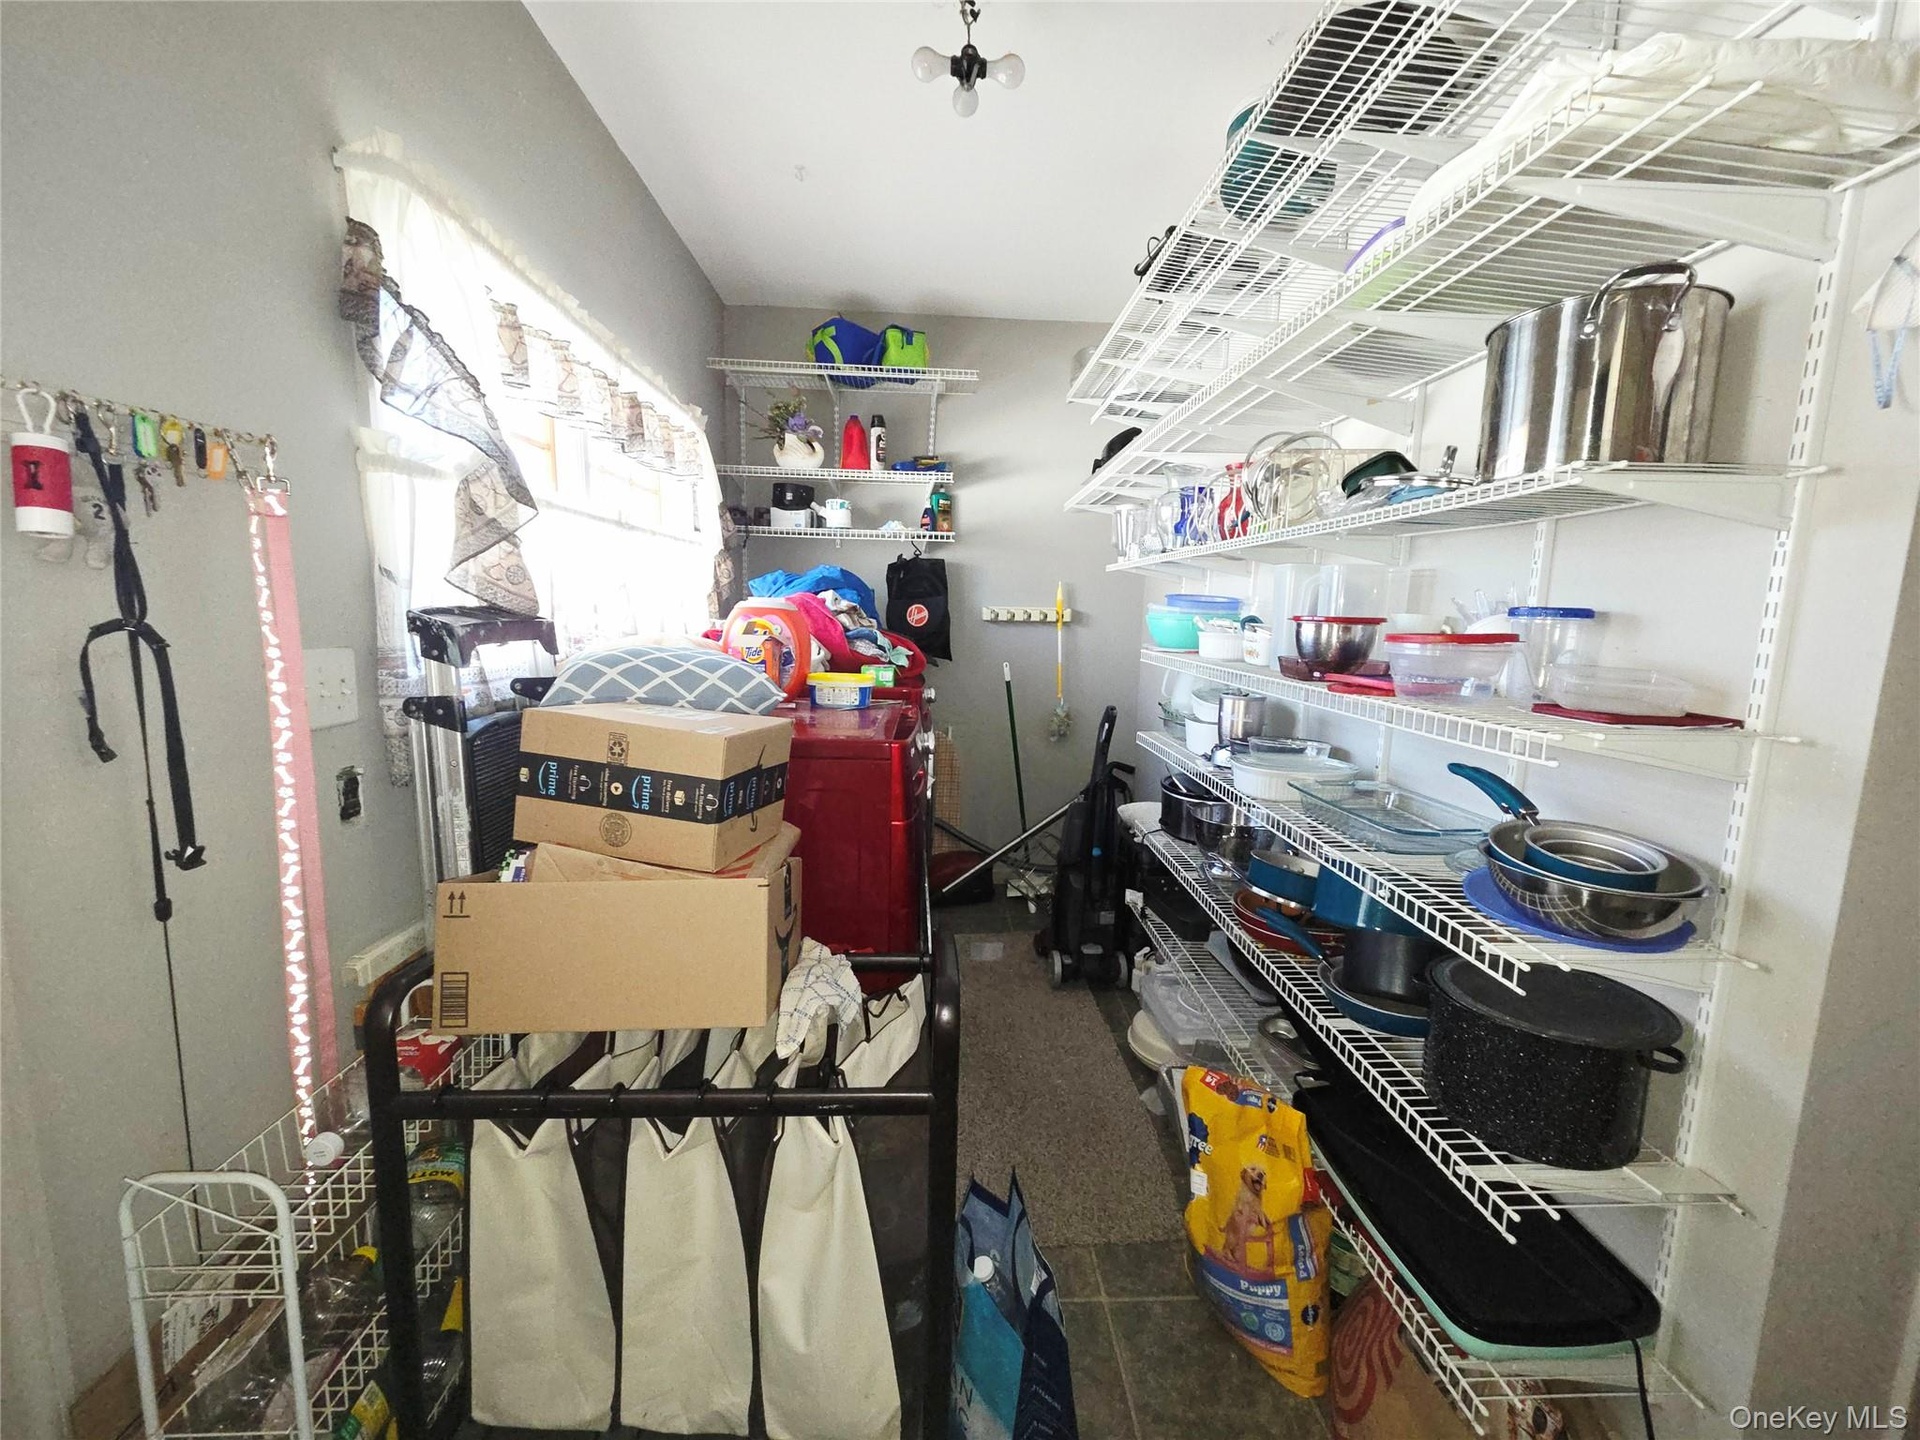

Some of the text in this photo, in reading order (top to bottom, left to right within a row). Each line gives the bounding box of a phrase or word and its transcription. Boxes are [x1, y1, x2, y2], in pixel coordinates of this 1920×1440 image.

[745, 646, 762, 658] Tide
[547, 761, 559, 796] prime
[641, 775, 653, 811] prime
[1204, 1074, 1218, 1087] 14
[1239, 1279, 1281, 1297] Puppy
